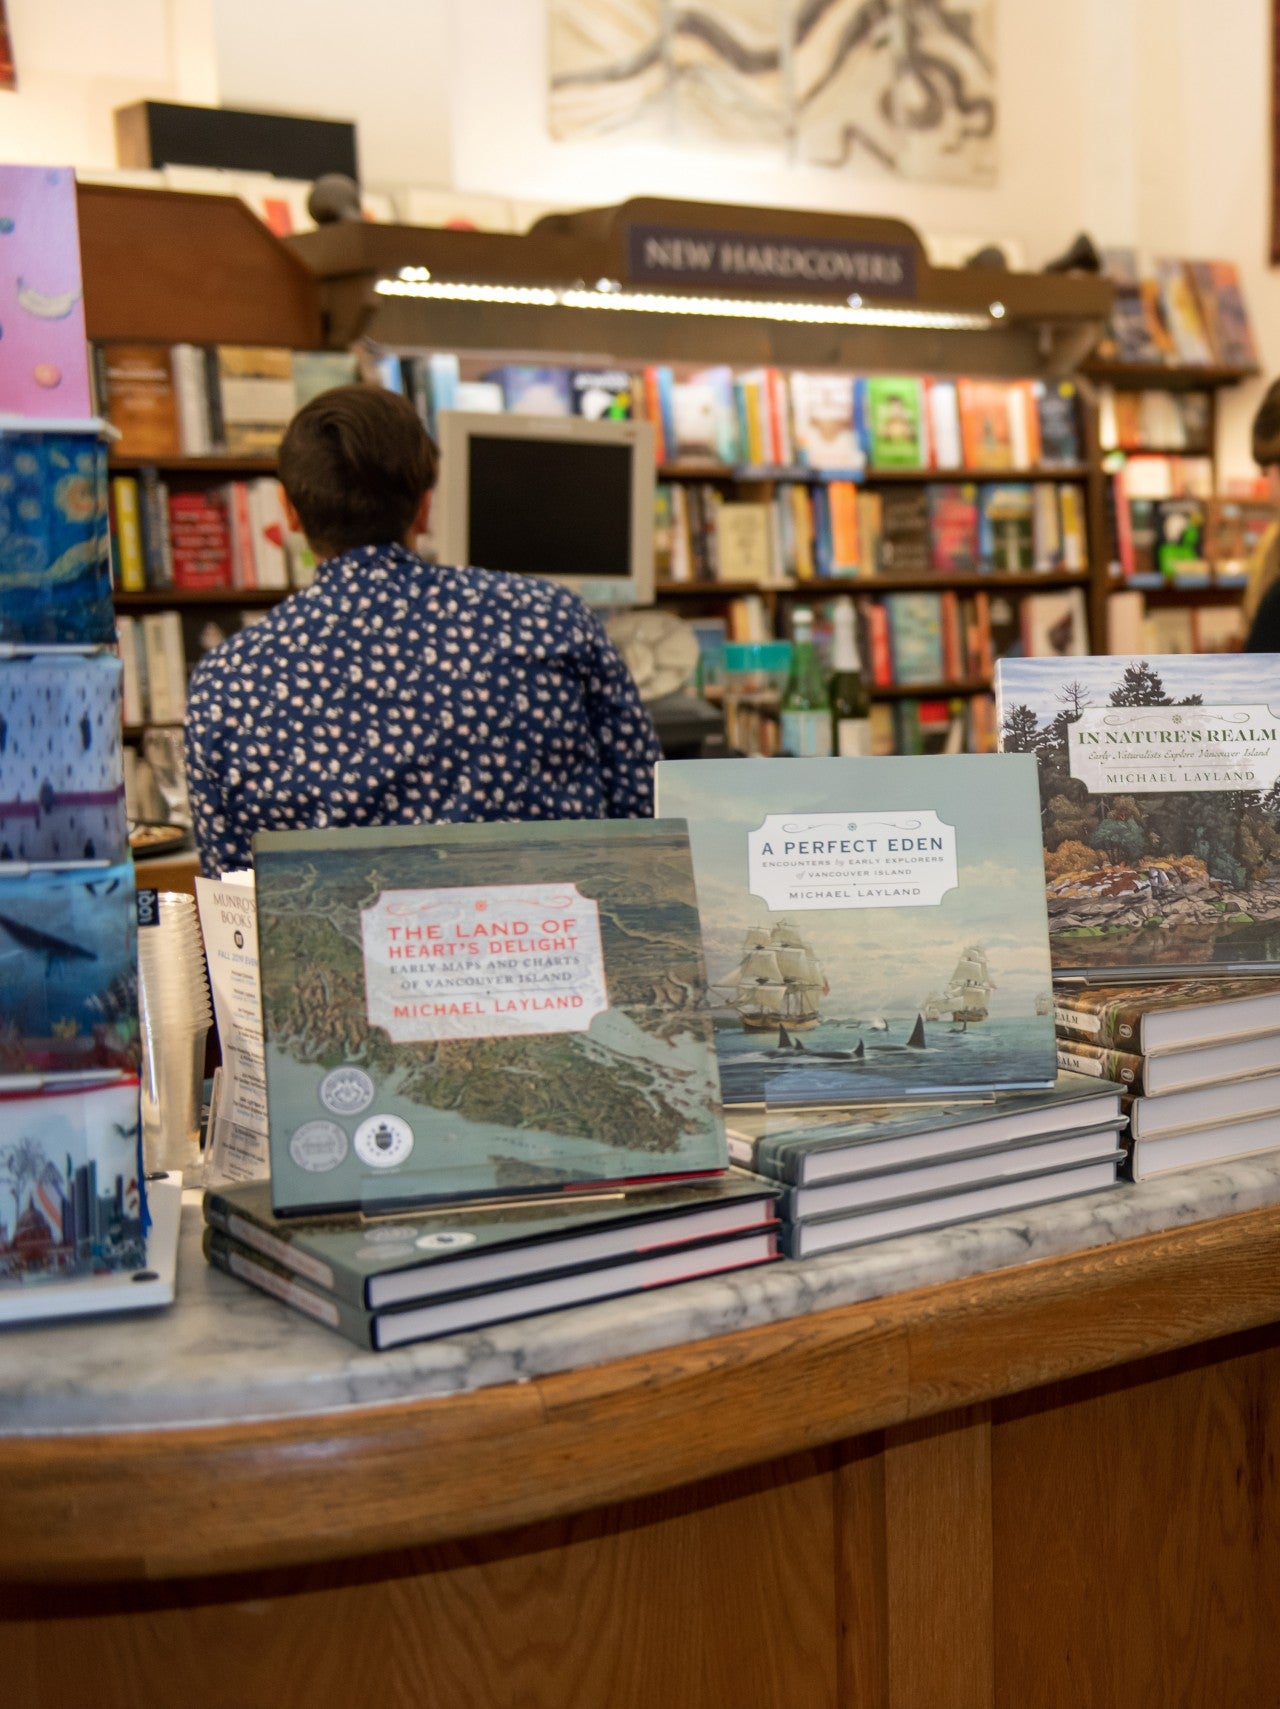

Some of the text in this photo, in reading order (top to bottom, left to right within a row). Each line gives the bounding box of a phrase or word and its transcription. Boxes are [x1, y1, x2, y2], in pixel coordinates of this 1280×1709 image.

[645, 237, 903, 285] NEW HARDCOVERS
[1078, 728, 1277, 745] IN NATURE'S REALM
[1088, 747, 1271, 764] Early Naturalists Explore Vancouver Island
[1105, 771, 1256, 784] MICHAEL LAYLAND
[761, 837, 944, 856] A PERFECT EDEN
[762, 860, 831, 869] ENCOUNTERS
[848, 858, 881, 866] EARLY
[885, 856, 944, 864] EXPLORERS
[808, 870, 870, 879] VANCOUVER
[874, 868, 912, 876] ISLAND
[789, 888, 921, 899] MICHAEL LAYLAND
[221, 911, 252, 929] BOOKS
[387, 918, 577, 941] THE LAND OF
[388, 937, 579, 959] HEART'S DELIGHT
[390, 956, 581, 975] EARLY MAPS AND CHARTS
[401, 971, 573, 991] OF VANCOUVER ISLAND
[393, 995, 585, 1019] MICHAEL LAYLAND
